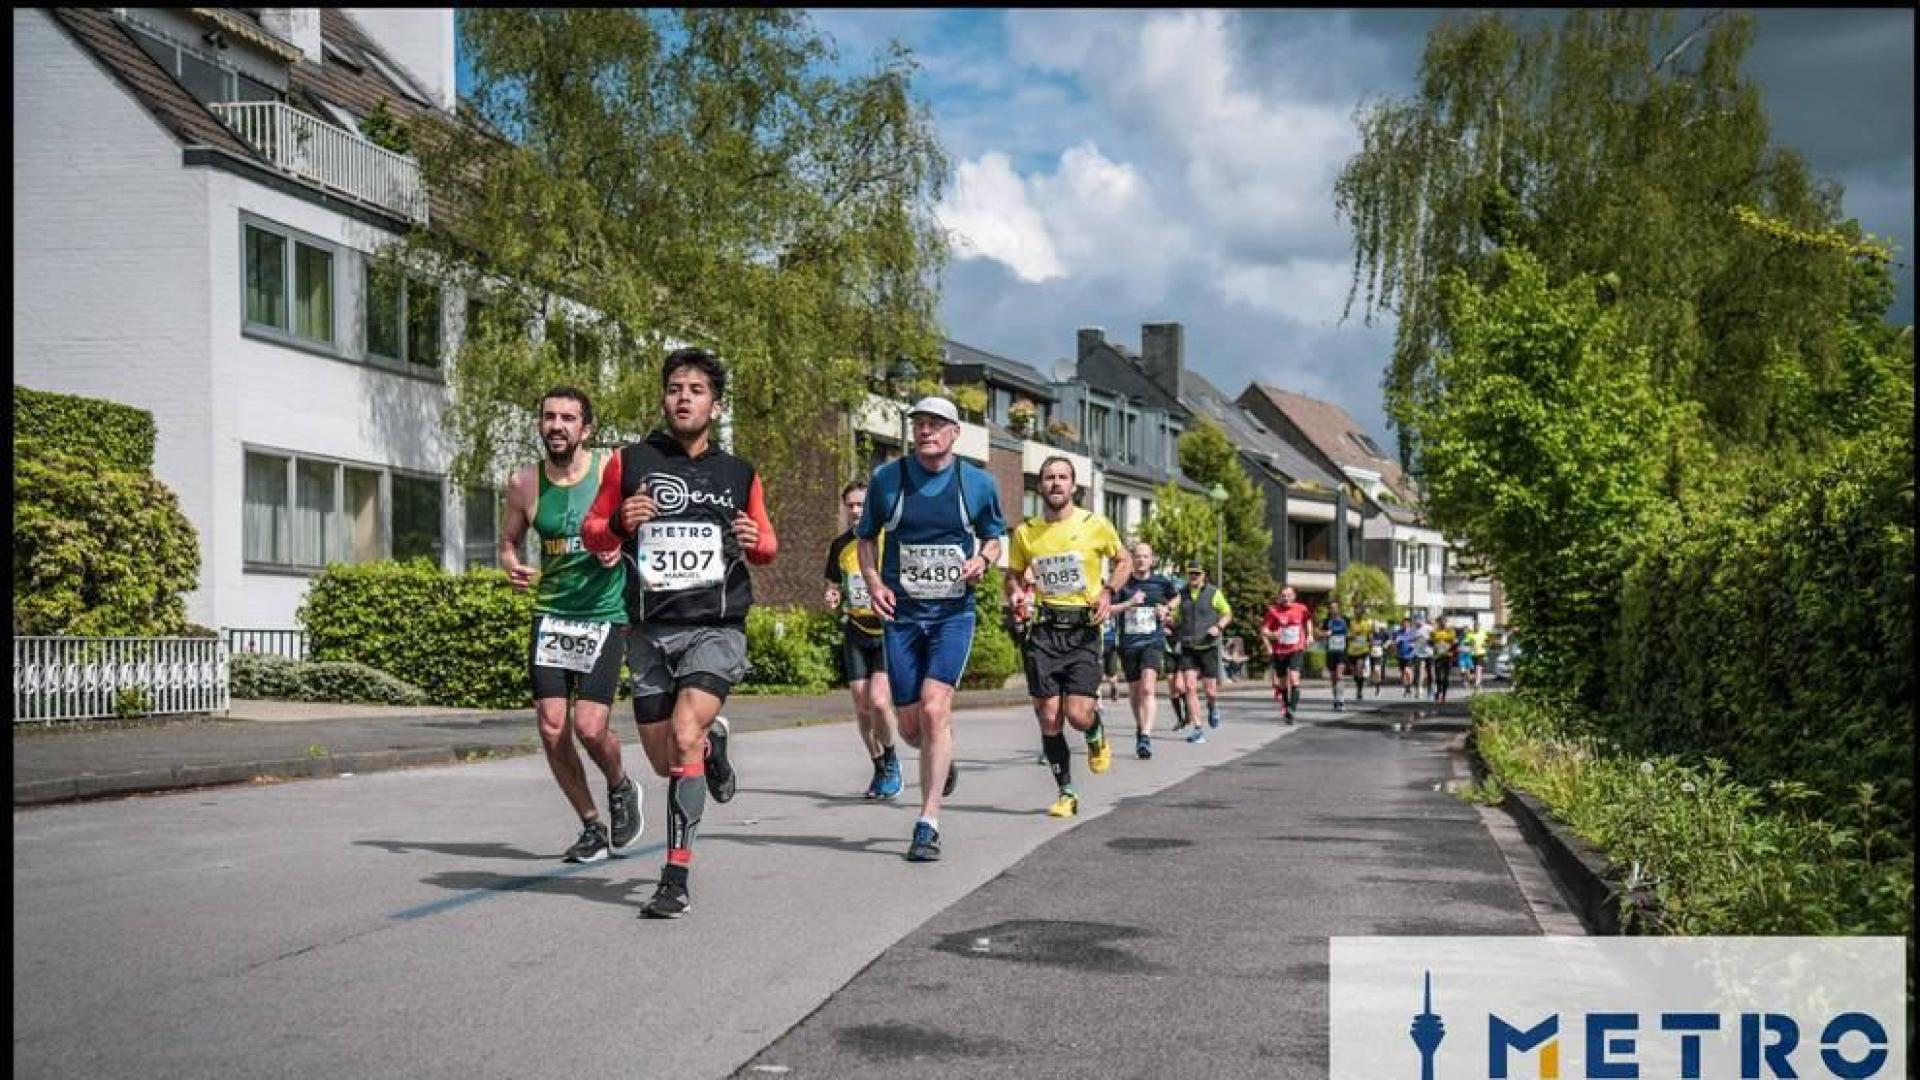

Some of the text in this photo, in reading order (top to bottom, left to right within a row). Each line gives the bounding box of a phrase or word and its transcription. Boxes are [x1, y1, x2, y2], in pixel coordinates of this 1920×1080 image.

[651, 526, 713, 538] METRO
[652, 550, 715, 571] 3107
[908, 548, 957, 558] METRO
[907, 565, 961, 582] 3480
[1041, 568, 1080, 585] 1083
[545, 633, 597, 656] 2058
